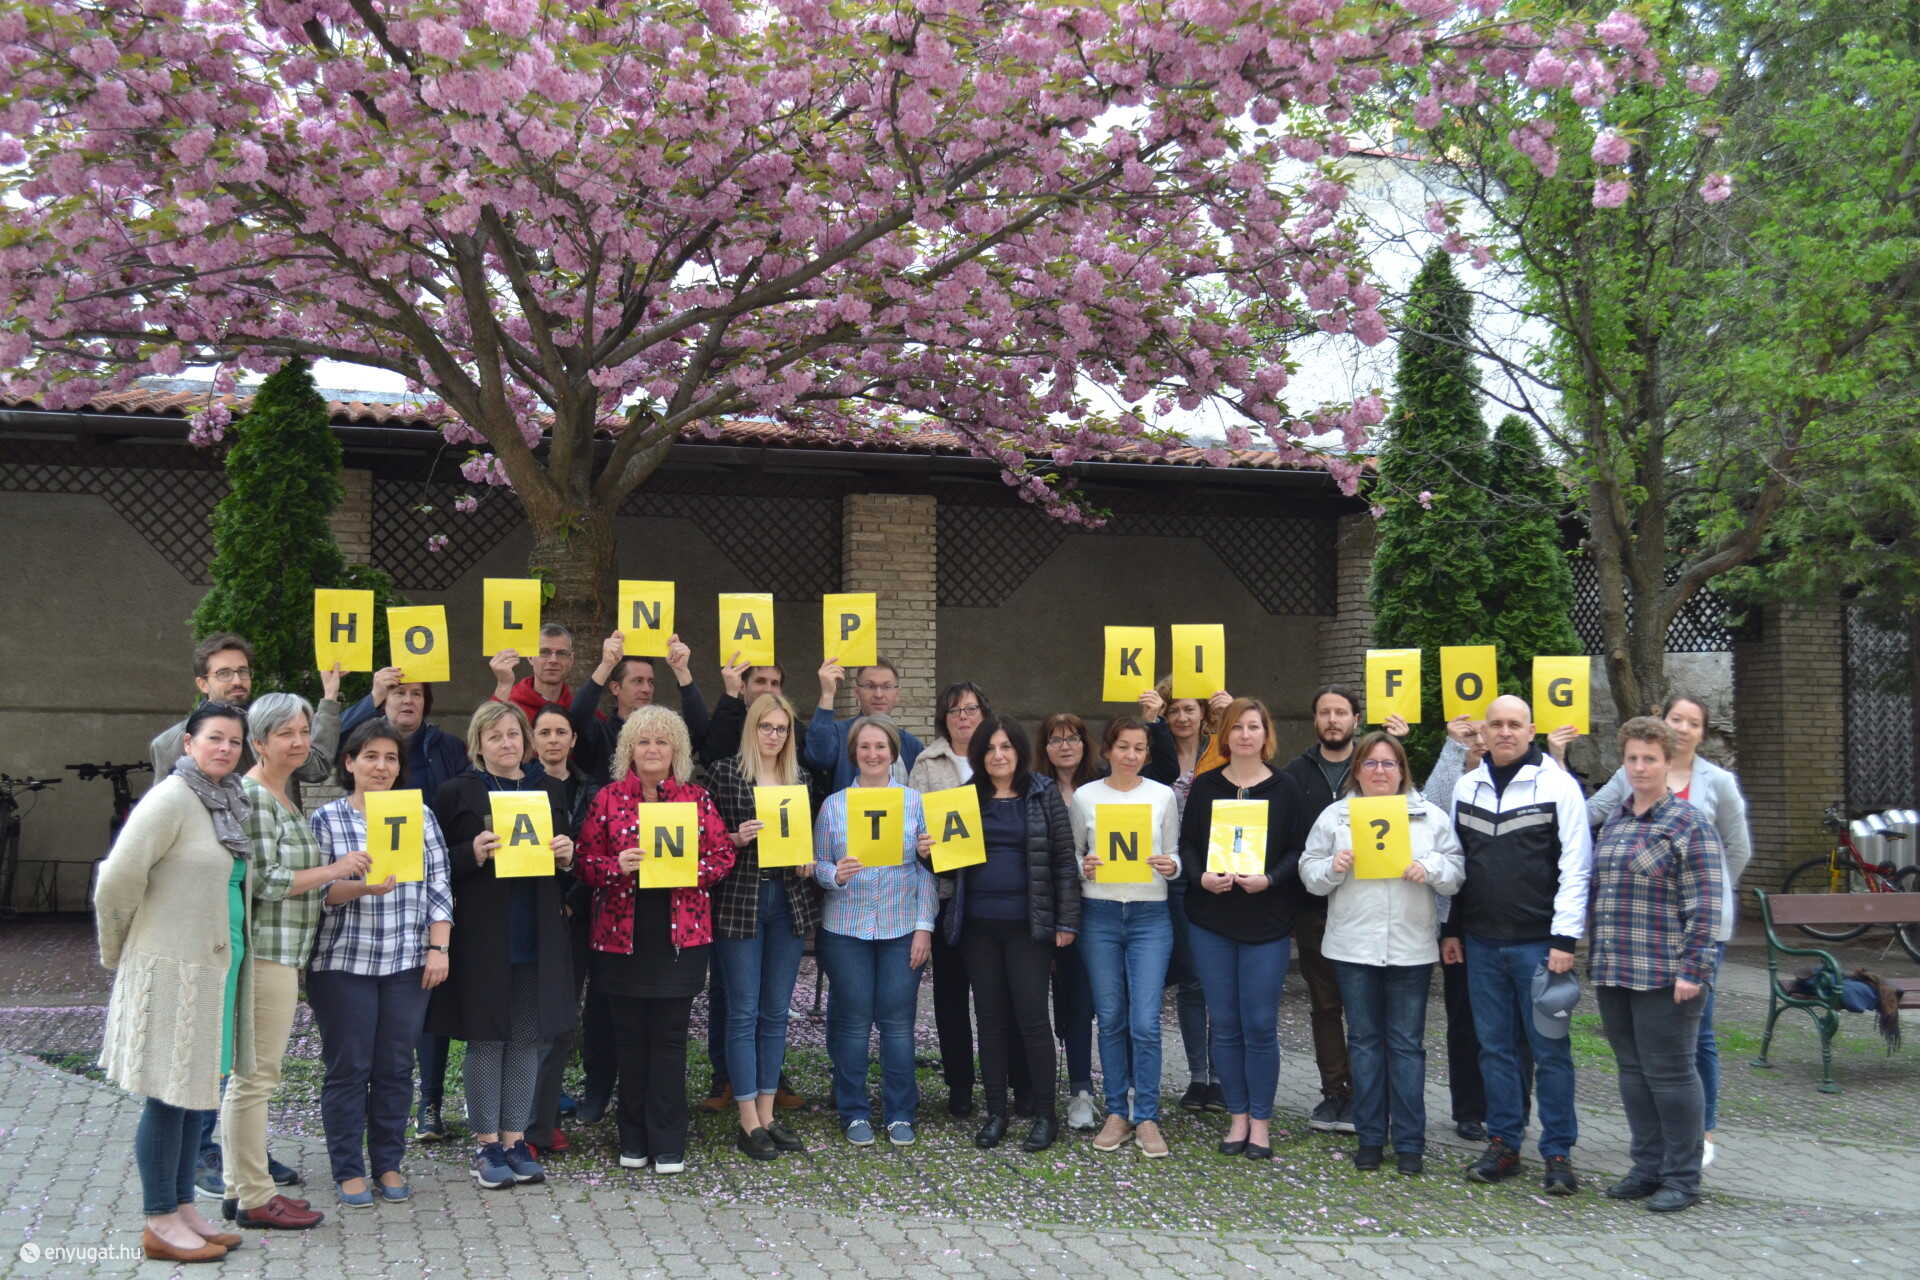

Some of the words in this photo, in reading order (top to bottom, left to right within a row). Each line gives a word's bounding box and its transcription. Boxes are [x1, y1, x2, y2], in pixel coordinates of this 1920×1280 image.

[330, 612, 358, 644] H
[404, 625, 434, 655] O
[503, 600, 524, 631] L
[632, 600, 661, 630] N
[733, 612, 761, 641] A
[840, 613, 861, 641] P
[1120, 647, 1142, 676] K
[1385, 669, 1403, 698] F
[1455, 672, 1484, 702] O
[1548, 677, 1573, 708] G
[384, 816, 407, 851] T
[509, 813, 540, 846] A
[654, 826, 684, 858] N
[779, 799, 791, 838] Í
[863, 810, 888, 841] T
[942, 810, 971, 843] A
[1109, 831, 1138, 862] N
[1369, 819, 1390, 851] ?
